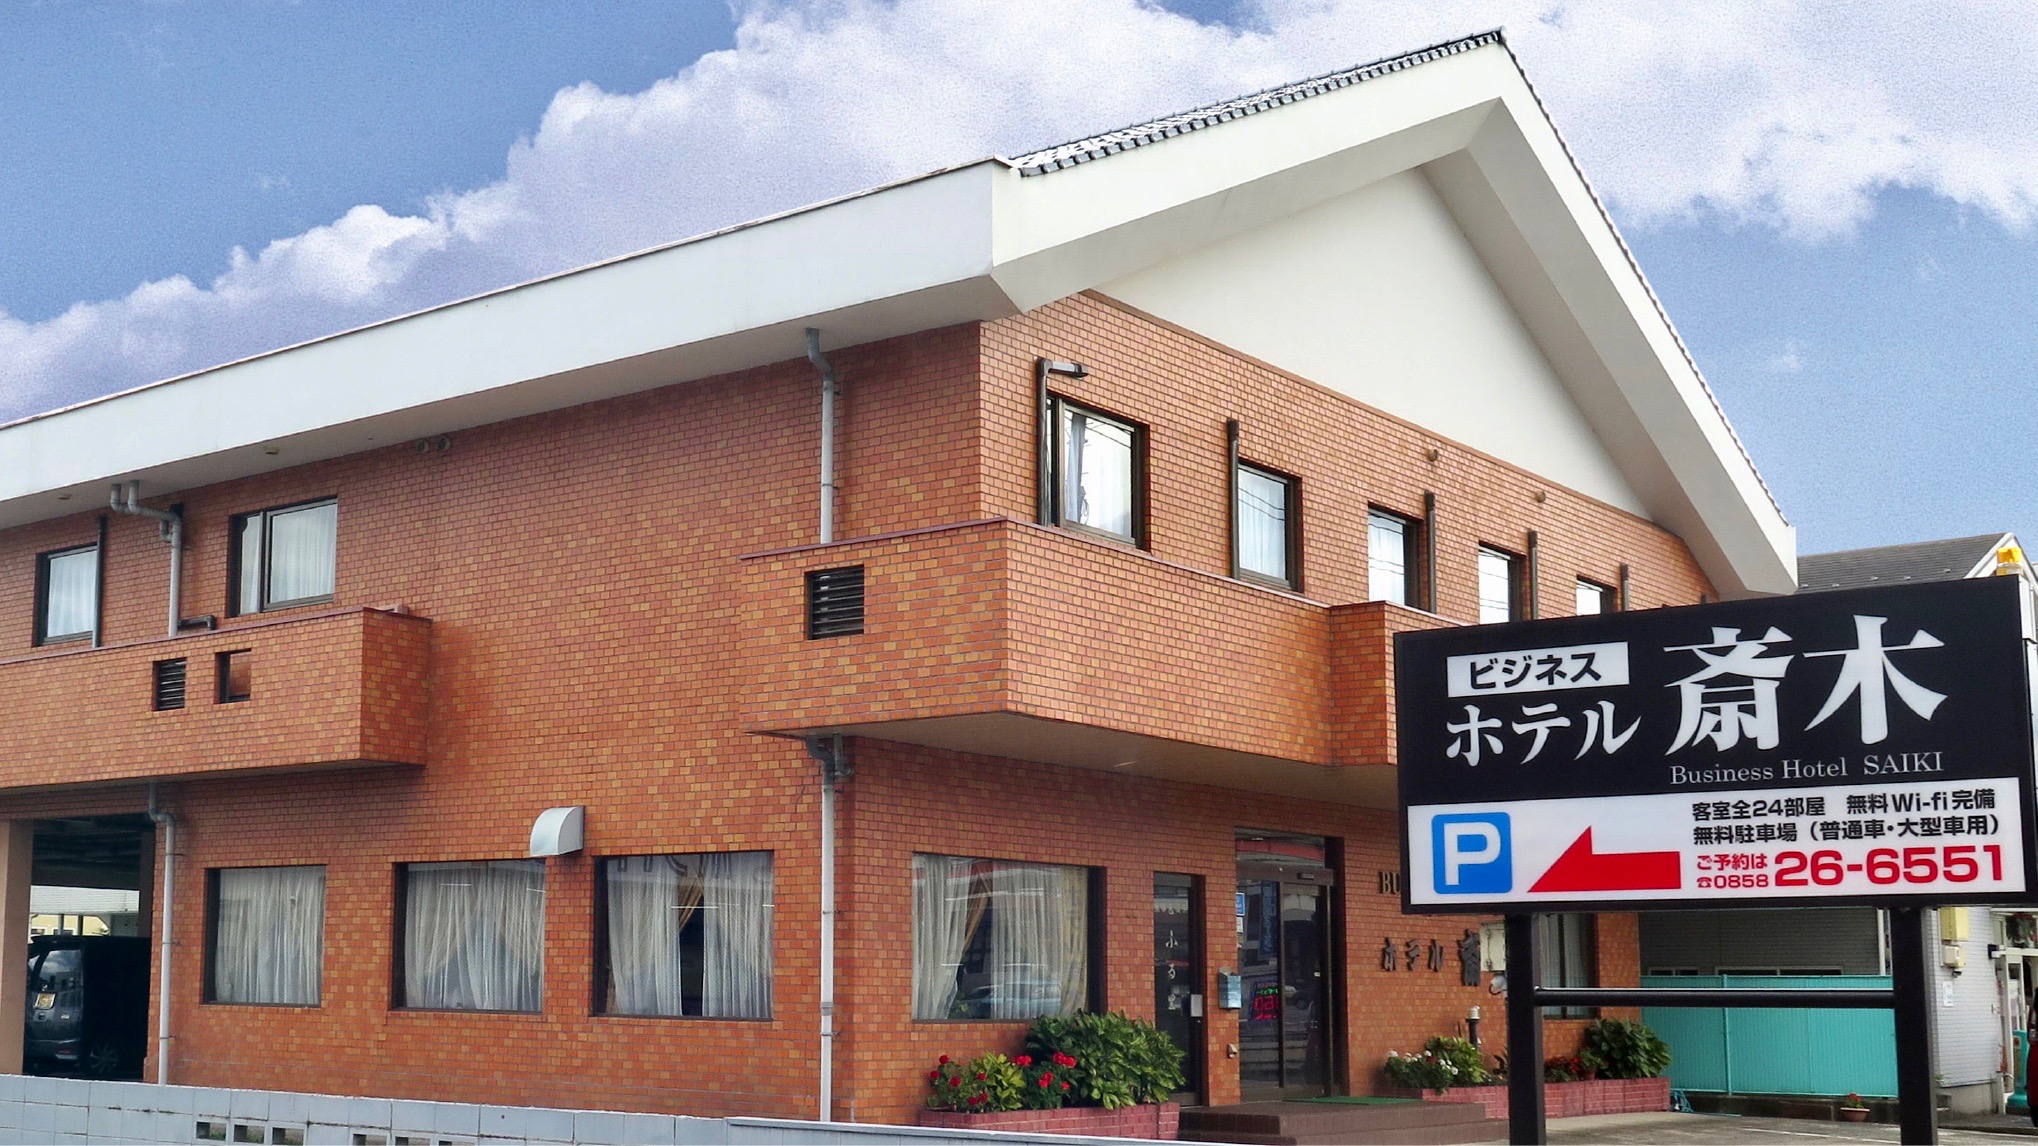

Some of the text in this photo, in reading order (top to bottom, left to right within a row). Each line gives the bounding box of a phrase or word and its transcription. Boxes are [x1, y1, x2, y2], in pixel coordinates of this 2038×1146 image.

[1470, 652, 1602, 690] ビジネス
[1446, 700, 1642, 767] ホテル
[1670, 751, 1944, 785] Business Hotel SAIKI
[1692, 797, 1826, 822] 客室全24部屋
[1444, 821, 1502, 886] P
[1697, 853, 1768, 871] ご予約は
[1775, 844, 2003, 887] 26-6551
[1714, 874, 1769, 889] 0858
